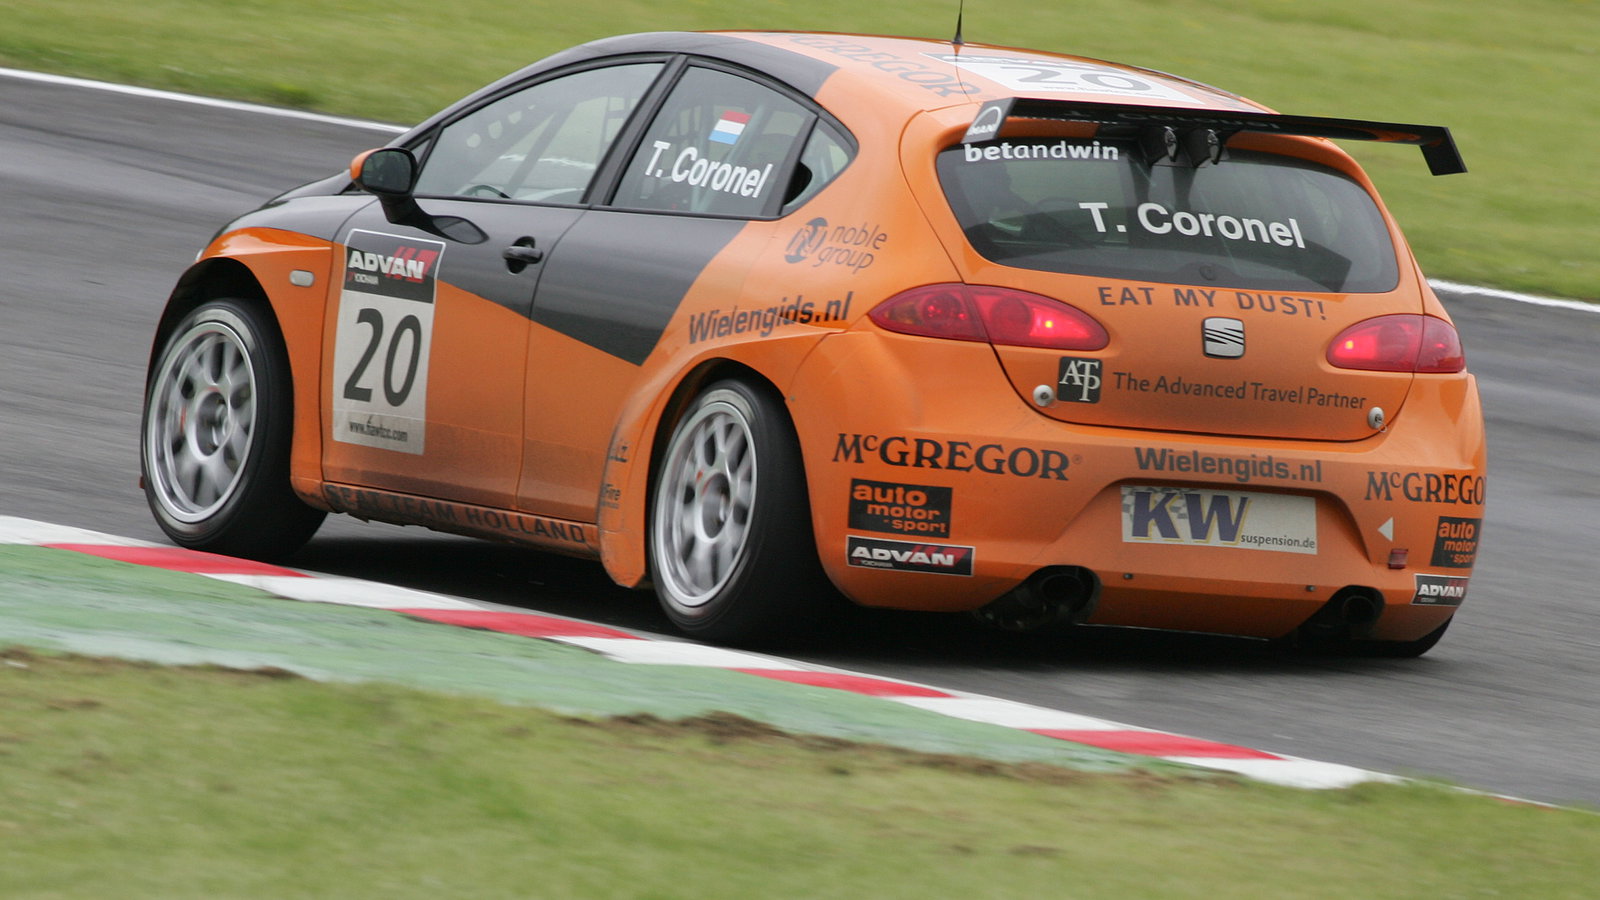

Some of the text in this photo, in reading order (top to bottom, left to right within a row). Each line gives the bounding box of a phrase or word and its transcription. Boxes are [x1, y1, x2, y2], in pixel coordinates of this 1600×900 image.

[999, 66, 1152, 91] 20
[964, 142, 1119, 162] betandwin
[645, 140, 773, 199] T. Coronel
[829, 222, 888, 250] noble
[1079, 202, 1306, 249] T. Coronel
[348, 250, 425, 279] ADVAN
[811, 247, 874, 275] group
[689, 291, 854, 345] Wielengids.nl
[1098, 287, 1327, 321] EAT MY DUST!
[342, 308, 422, 407] 20
[1112, 372, 1367, 410] The Advanced Travel Partner
[832, 433, 1070, 481] McGREGOR
[1134, 447, 1322, 483] Wielengids.nl
[853, 484, 928, 506] auto
[1364, 471, 1487, 505] McGREGO
[394, 494, 457, 522] TEAM
[465, 508, 586, 544] HOLLAND
[866, 504, 940, 520] motor
[1131, 491, 1253, 546] KW
[1240, 534, 1316, 549] suspension.de
[1438, 522, 1475, 539] auto
[850, 546, 955, 567] ADVAN
[1444, 540, 1476, 552] motor
[1418, 584, 1465, 598] ADVAN
